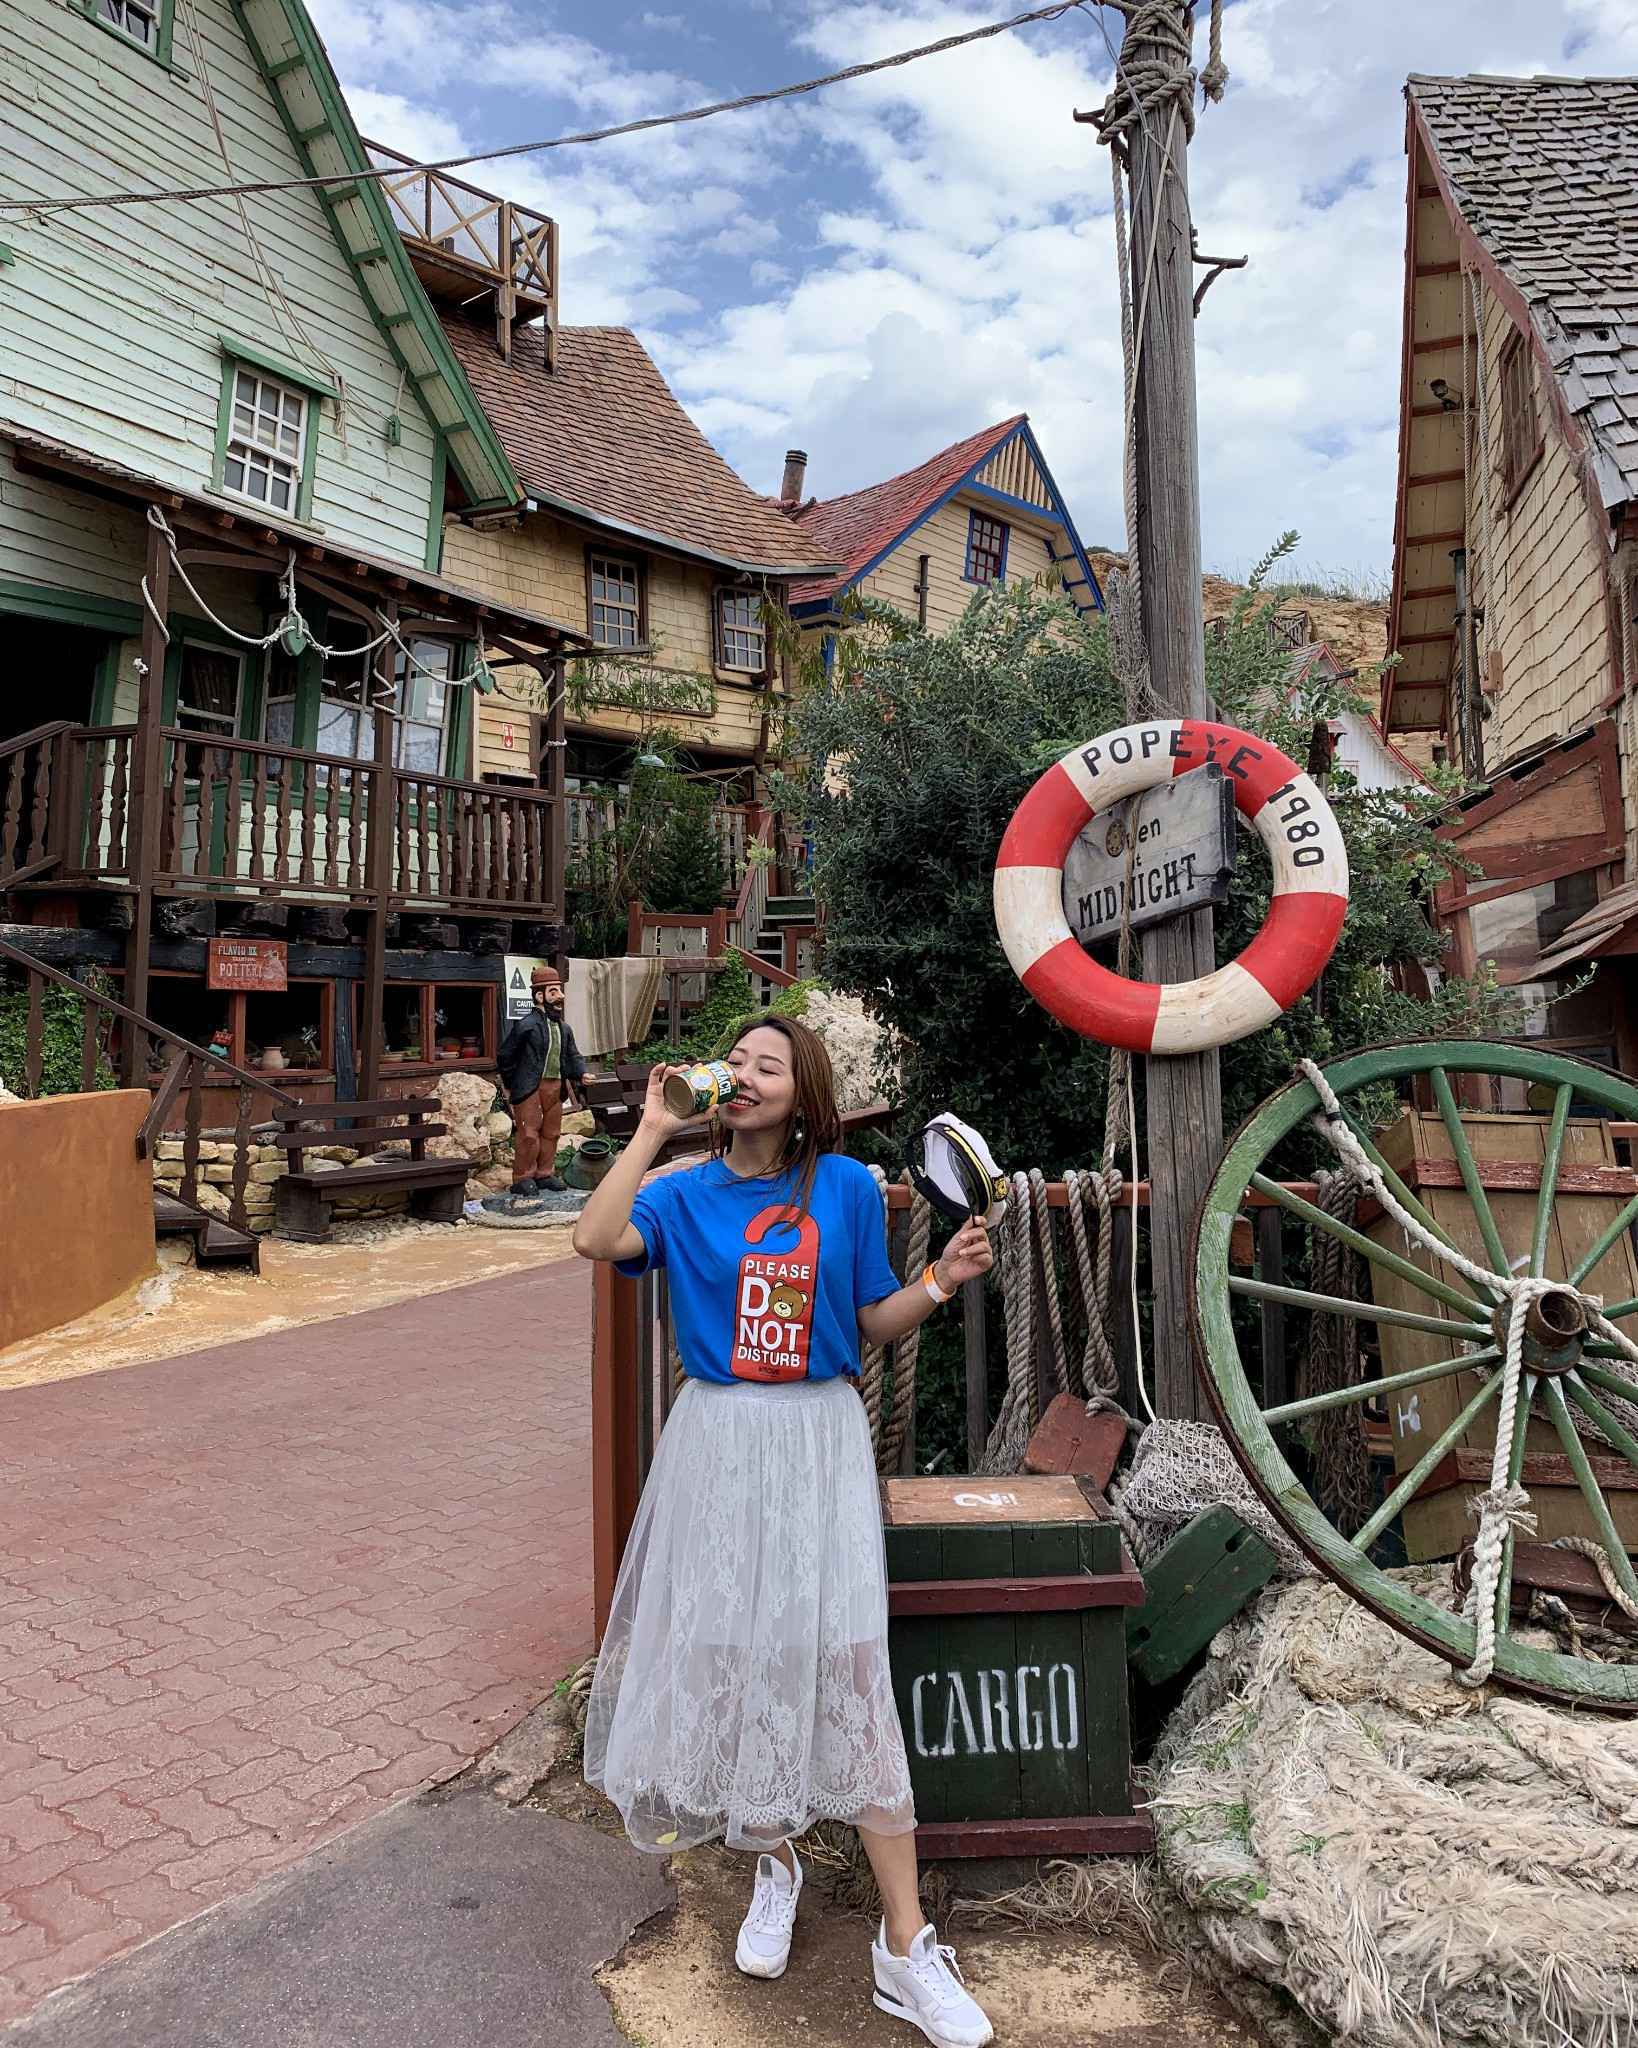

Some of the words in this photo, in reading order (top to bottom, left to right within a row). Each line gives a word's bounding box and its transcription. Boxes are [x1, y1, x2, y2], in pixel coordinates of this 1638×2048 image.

[1081, 729, 1263, 779] POPEYE
[1266, 783, 1325, 868] 1980
[1078, 853, 1196, 930] MIDNIGHT
[745, 1259, 811, 1280] PLEASE
[737, 1345, 801, 1368] DISTURB
[739, 1317, 804, 1352] NOT
[911, 1663, 1079, 1757] CARGO
